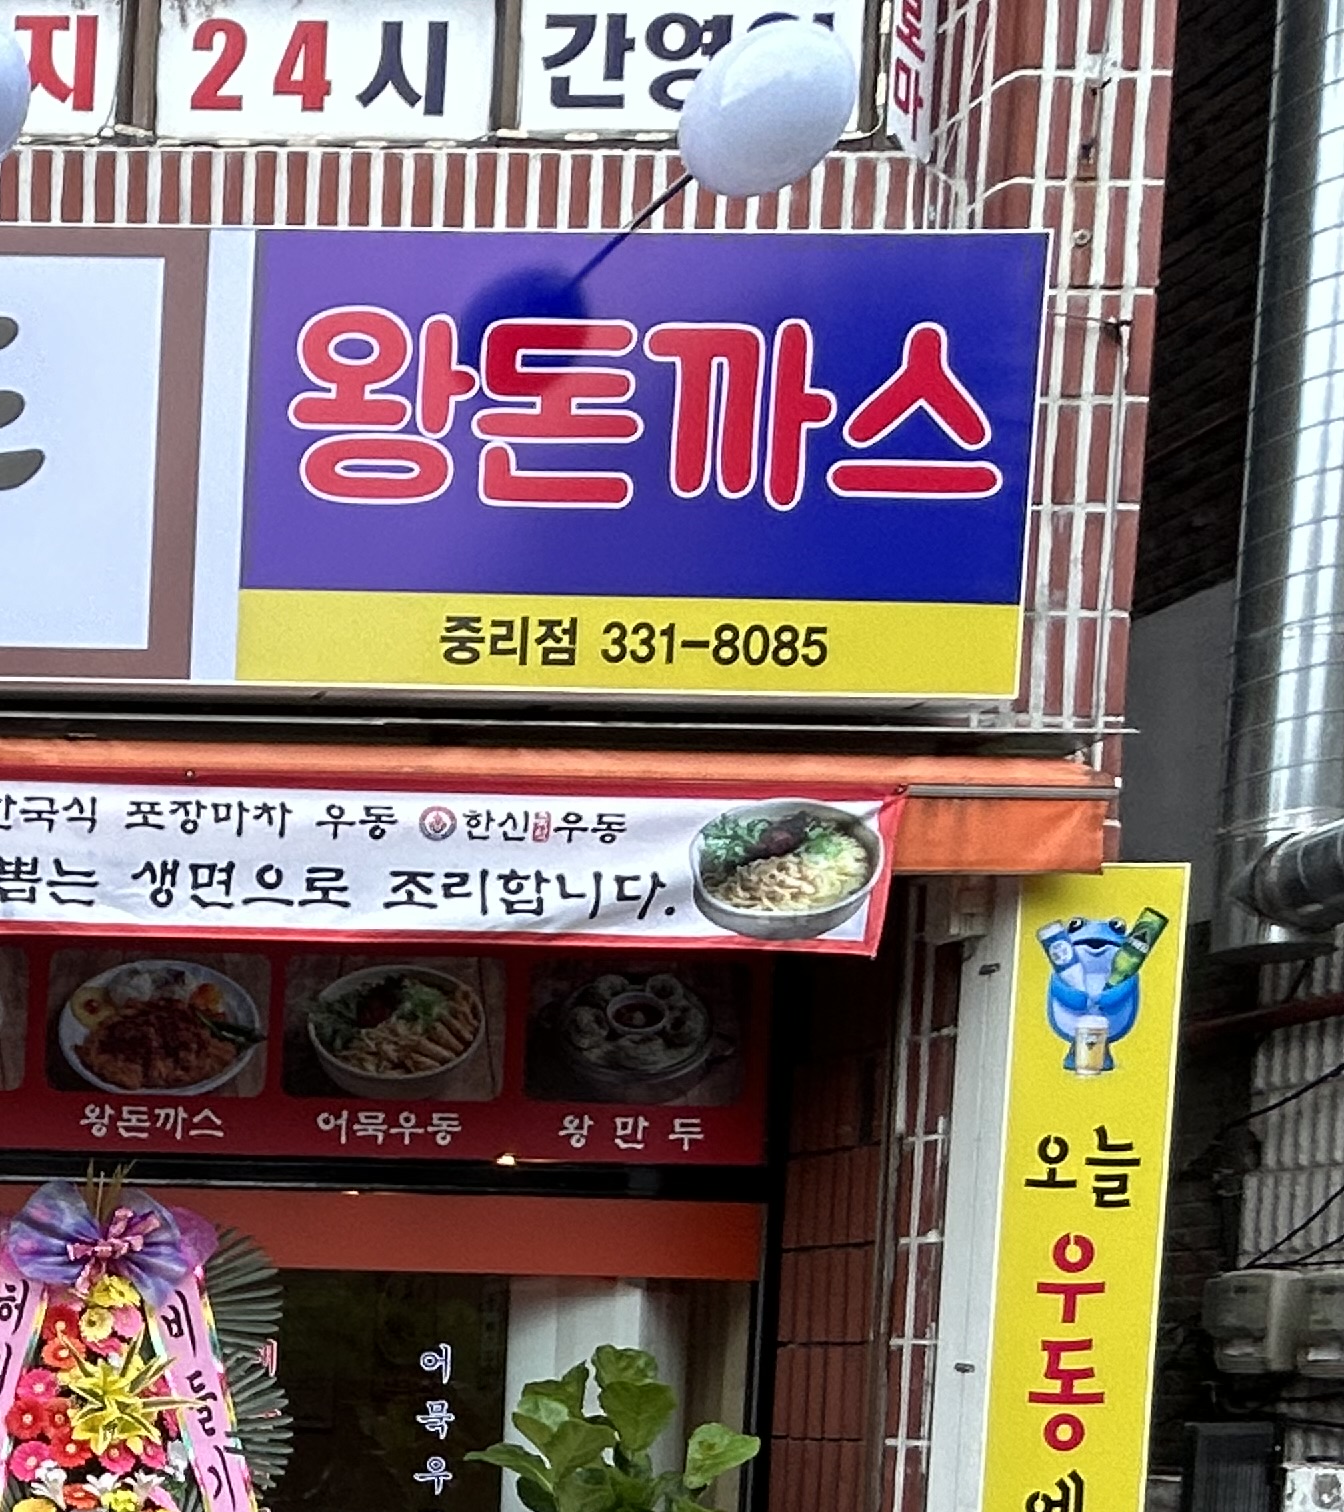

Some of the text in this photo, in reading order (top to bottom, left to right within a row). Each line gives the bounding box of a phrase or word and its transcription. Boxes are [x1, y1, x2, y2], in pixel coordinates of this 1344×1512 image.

[189, 15, 448, 116] 24시
[541, 12, 835, 110] 간영
[287, 304, 1004, 510] 왕돈까스
[439, 613, 829, 668] 중리점 331-8085
[124, 797, 293, 837] 포장마차
[316, 804, 398, 841] 우동
[131, 858, 350, 909] 생면으로
[383, 868, 676, 921] 조리합니다.
[79, 1103, 226, 1142] 왕돈까스
[316, 1110, 463, 1147] 어묵우동
[1023, 1124, 1141, 1209] 오늘
